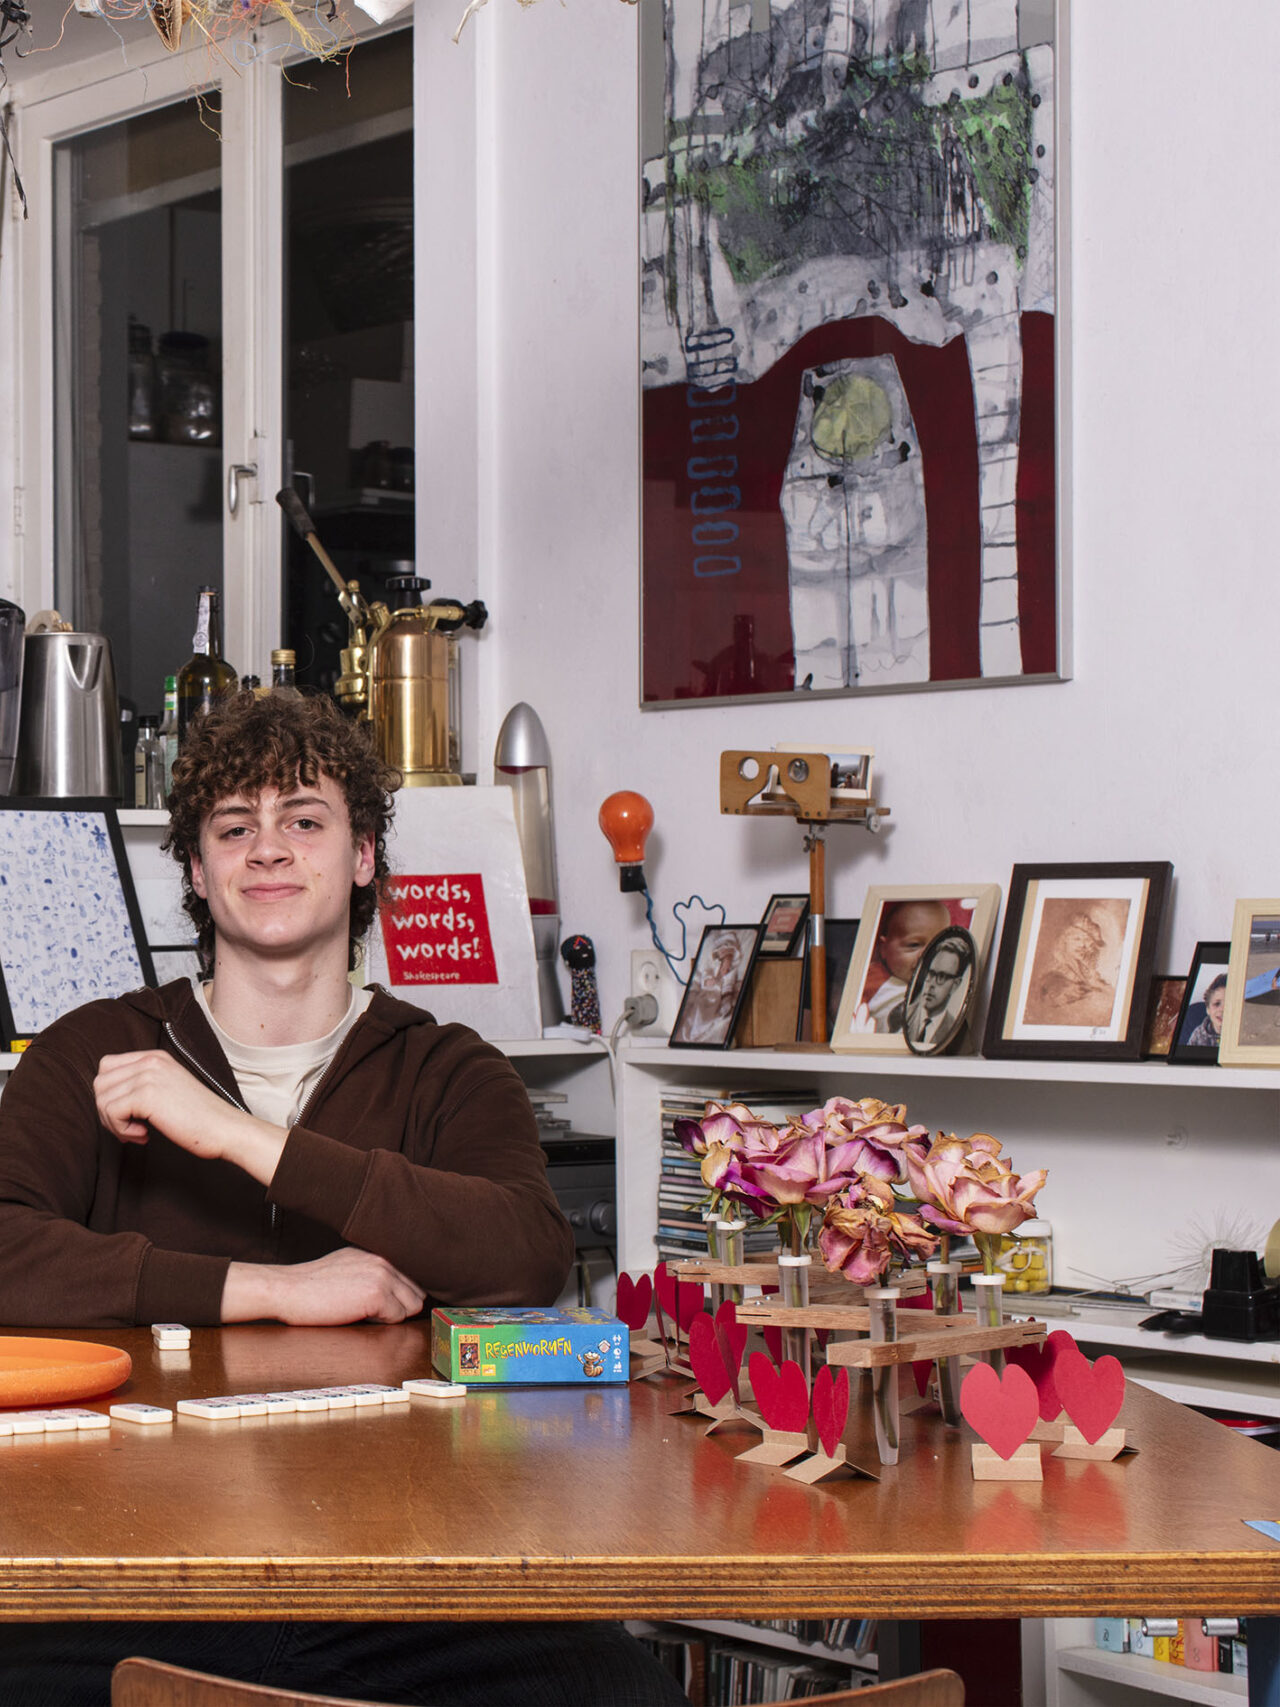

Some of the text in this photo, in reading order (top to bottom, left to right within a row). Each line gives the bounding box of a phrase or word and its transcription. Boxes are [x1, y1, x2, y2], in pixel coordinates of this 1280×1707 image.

[388, 878, 471, 903] words,
[392, 907, 475, 932] words,
[396, 937, 480, 960] words!
[485, 1337, 573, 1359] REGENWORMEN
